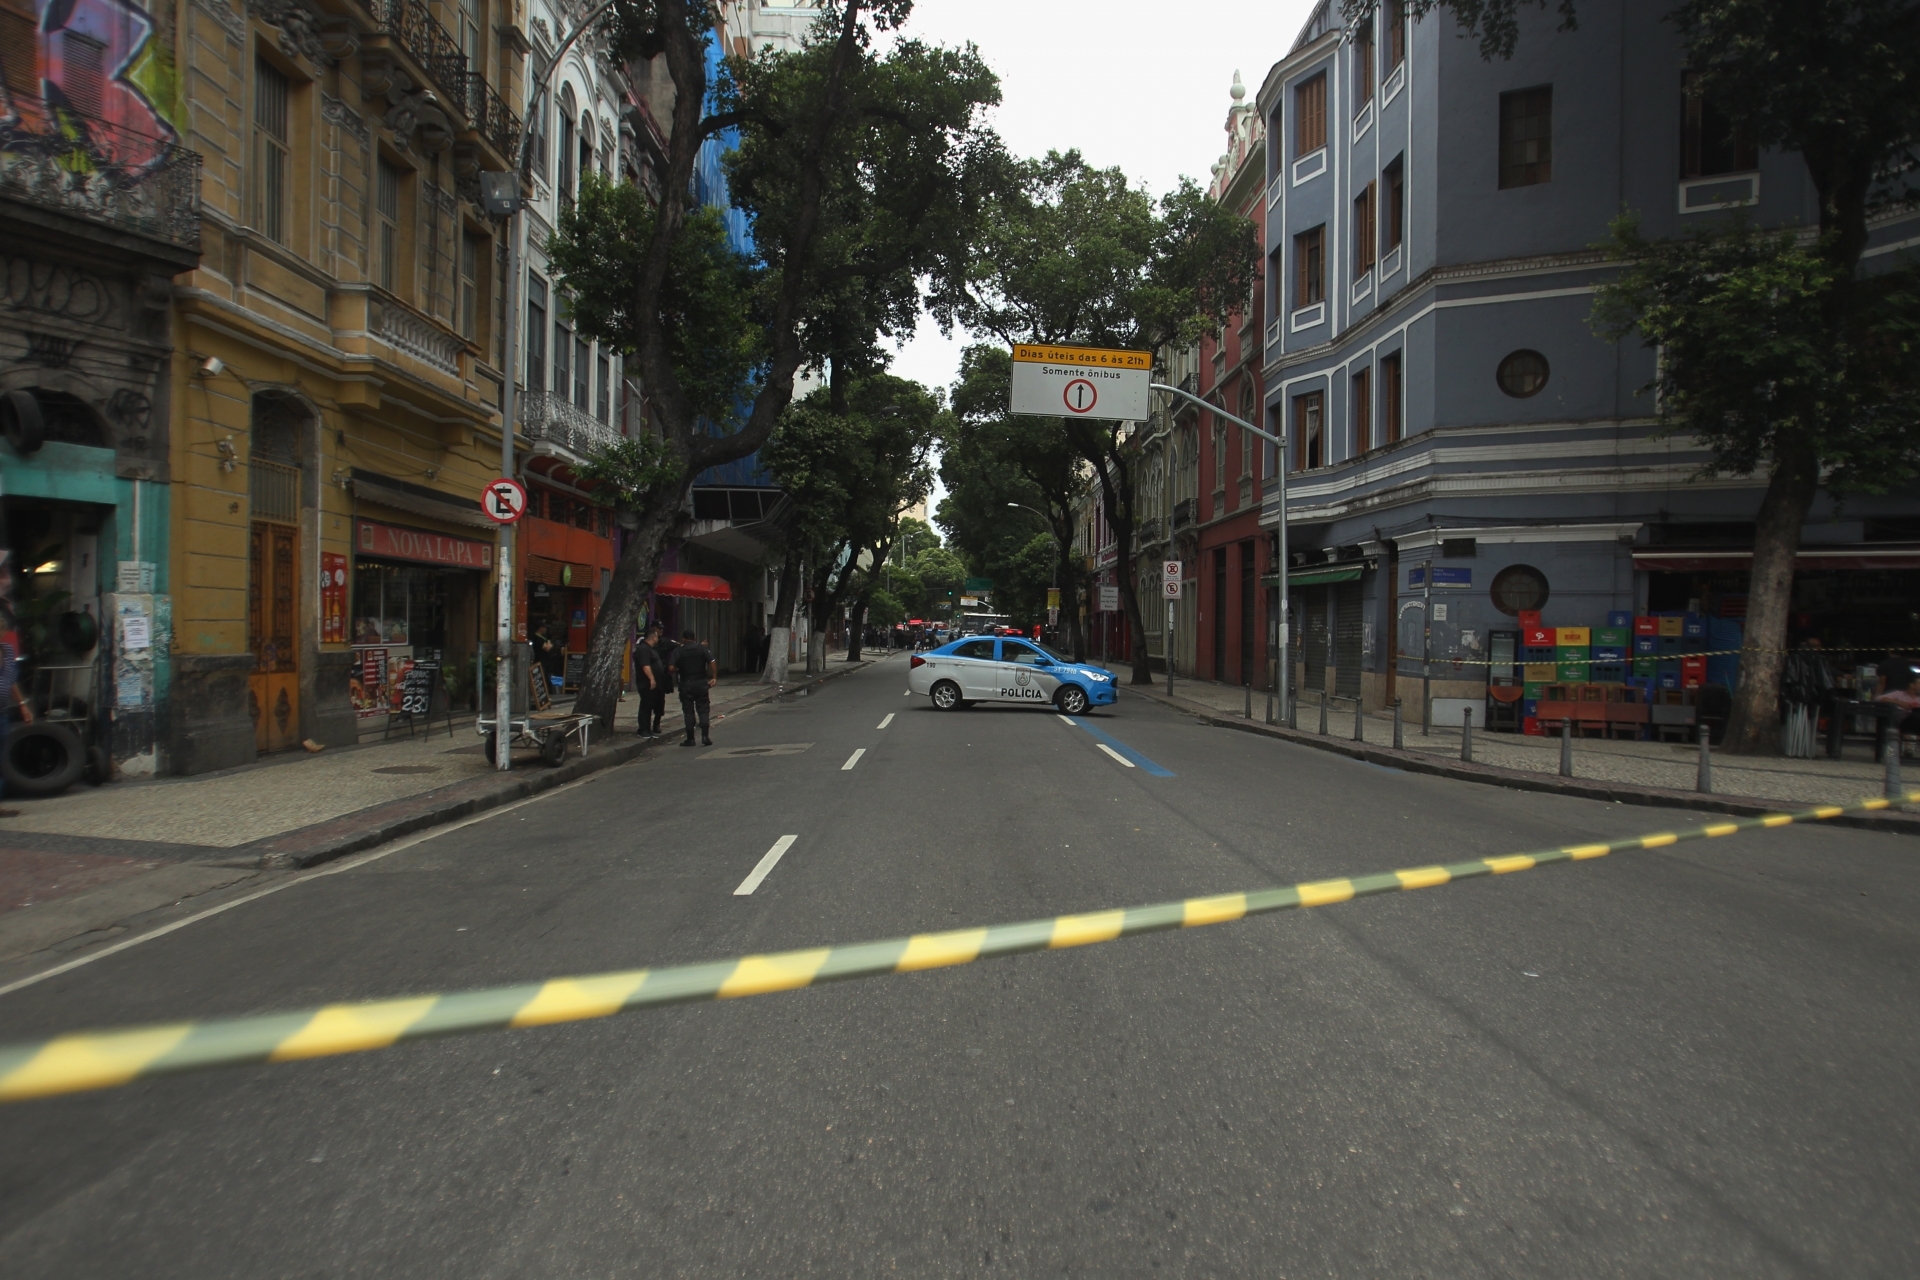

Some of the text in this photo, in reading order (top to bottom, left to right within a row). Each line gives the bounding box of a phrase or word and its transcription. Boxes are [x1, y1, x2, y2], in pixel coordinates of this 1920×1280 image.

[1020, 349, 1144, 365] Dias úteis das 6 às 21h
[1042, 367, 1121, 379] Somente ônibus
[388, 529, 473, 564] NOVA LAPA
[1001, 688, 1043, 699] POLÍCIA
